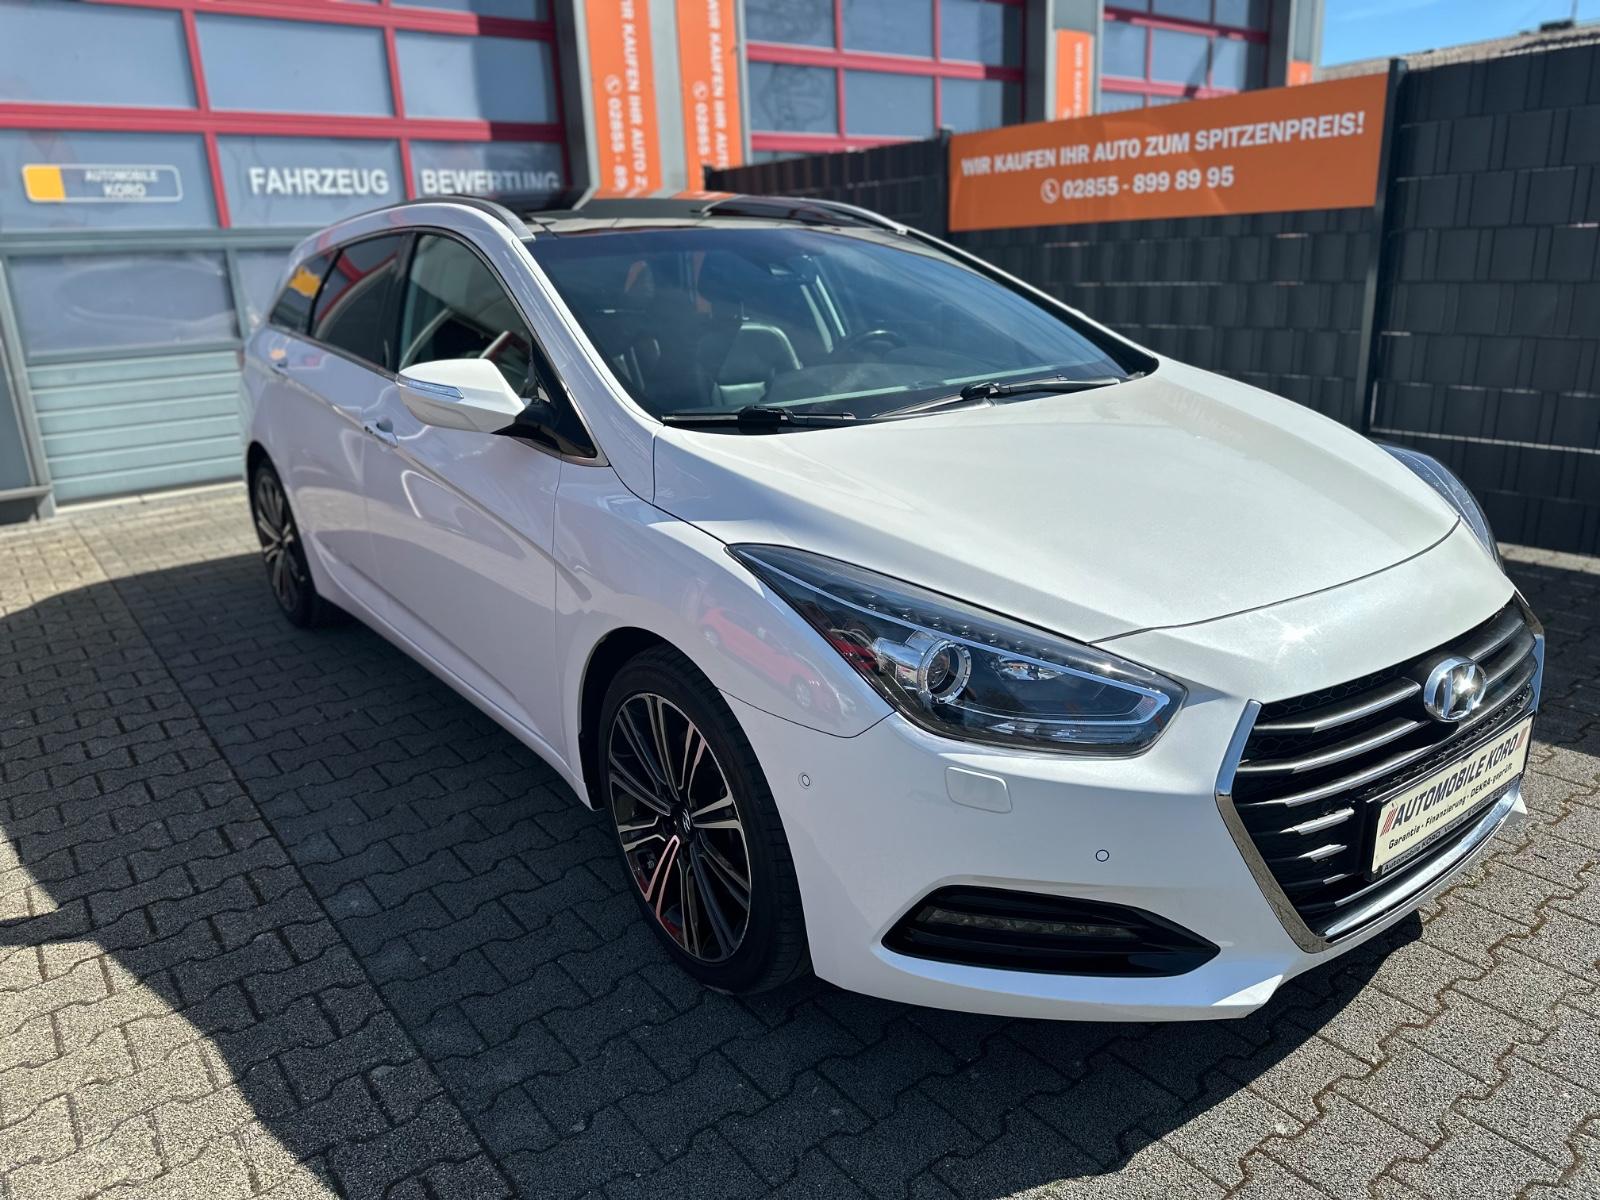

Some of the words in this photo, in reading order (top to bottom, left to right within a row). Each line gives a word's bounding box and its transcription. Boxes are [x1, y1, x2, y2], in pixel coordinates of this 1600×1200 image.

[622, 23, 640, 92] KAUFEN
[710, 32, 724, 97] KAUFEN
[608, 97, 626, 154] 02855
[628, 94, 643, 125] IHR
[713, 99, 727, 129] IHR
[631, 128, 647, 172] AUTO
[961, 156, 992, 176] WIR
[994, 148, 1057, 173] KAUFEN
[1060, 144, 1090, 166] IHR
[1093, 138, 1141, 162] AUTO
[1144, 132, 1190, 157] ZUM
[1195, 111, 1365, 151] SPITZENPREIS!
[85, 170, 158, 182] AUTOMOBILE
[103, 183, 146, 197] KORO
[249, 166, 389, 195] FAHRZEUG
[421, 169, 560, 194] BEWERTUNG
[1062, 175, 1119, 200] 02855
[1132, 171, 1170, 194] 899
[1175, 168, 1201, 190] 89
[1206, 165, 1234, 188] 95
[1392, 754, 1487, 830] AUTOMOBILE
[1484, 732, 1519, 772] KORO
[1388, 825, 1420, 850] Garantie
[1424, 796, 1466, 828] Finanzierung
